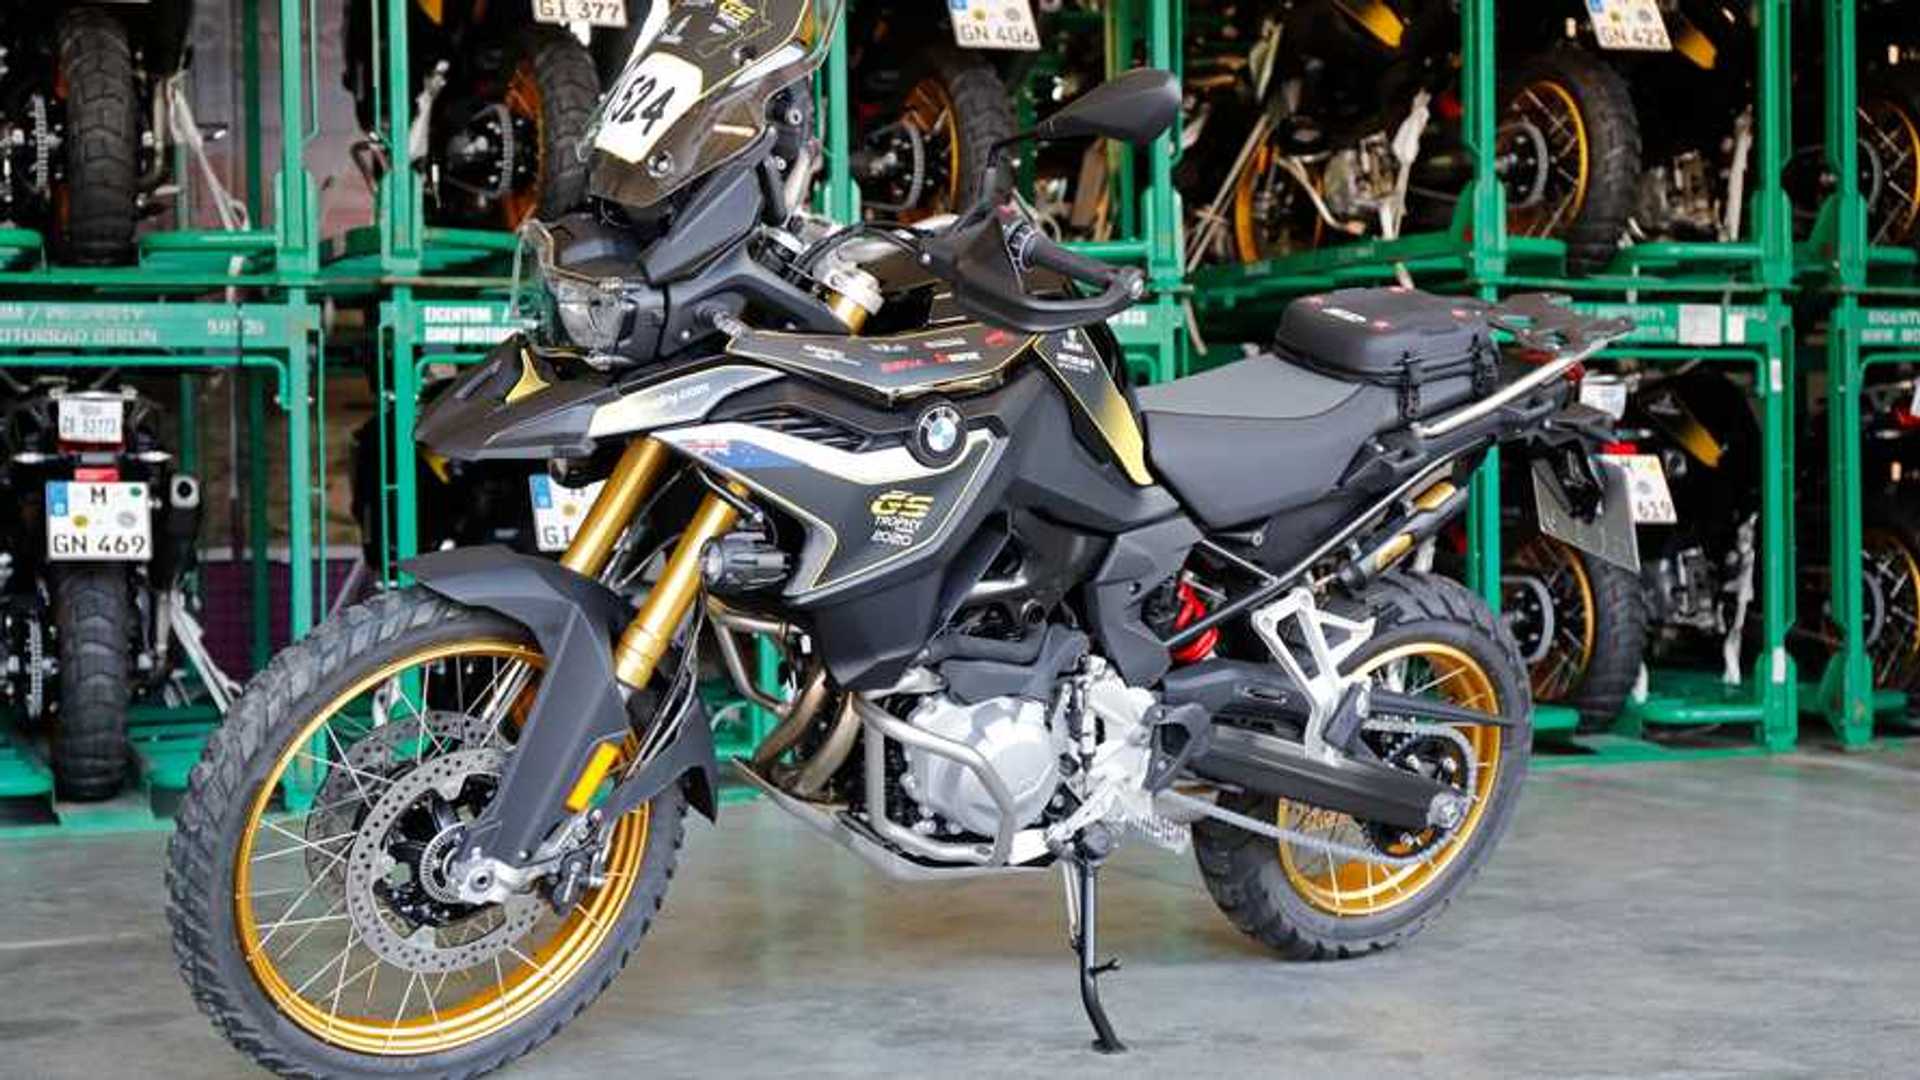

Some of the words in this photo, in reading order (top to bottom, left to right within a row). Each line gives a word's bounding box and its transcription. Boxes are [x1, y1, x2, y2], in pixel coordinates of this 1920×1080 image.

[578, 2, 620, 19] 377
[90, 486, 107, 503] M
[870, 489, 935, 518] GS
[875, 516, 922, 530] TROPHY
[54, 535, 88, 554] GN
[97, 535, 146, 554] 469
[871, 530, 914, 546] 2020
